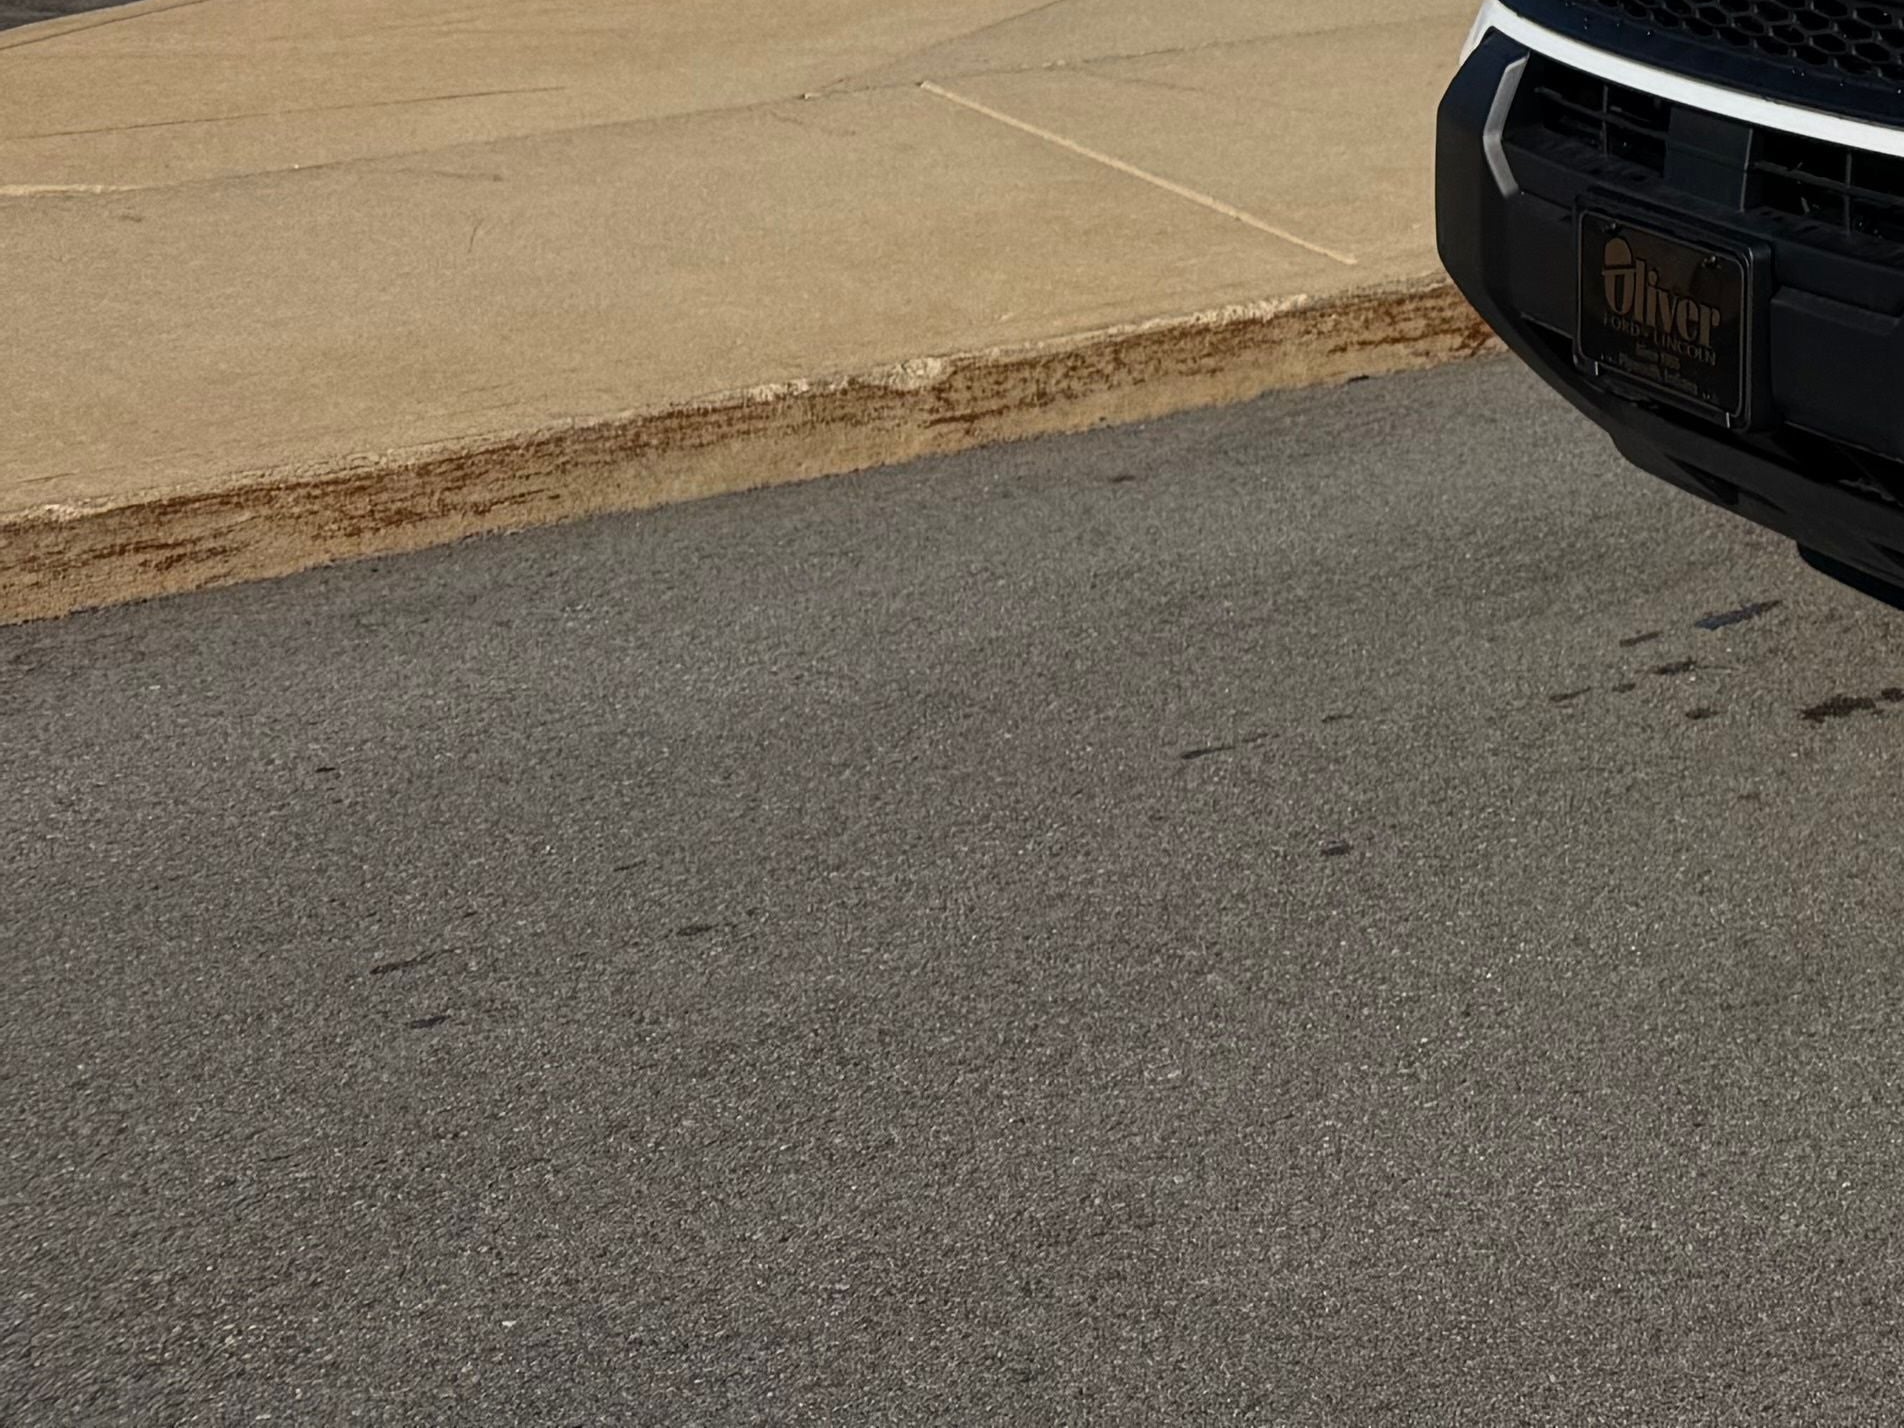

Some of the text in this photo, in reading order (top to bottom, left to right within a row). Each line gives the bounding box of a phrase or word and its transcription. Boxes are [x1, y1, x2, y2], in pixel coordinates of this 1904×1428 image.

[1601, 237, 1722, 347] Oliver
[1603, 312, 1642, 337] FORD
[1653, 330, 1717, 366] LINCOLN
